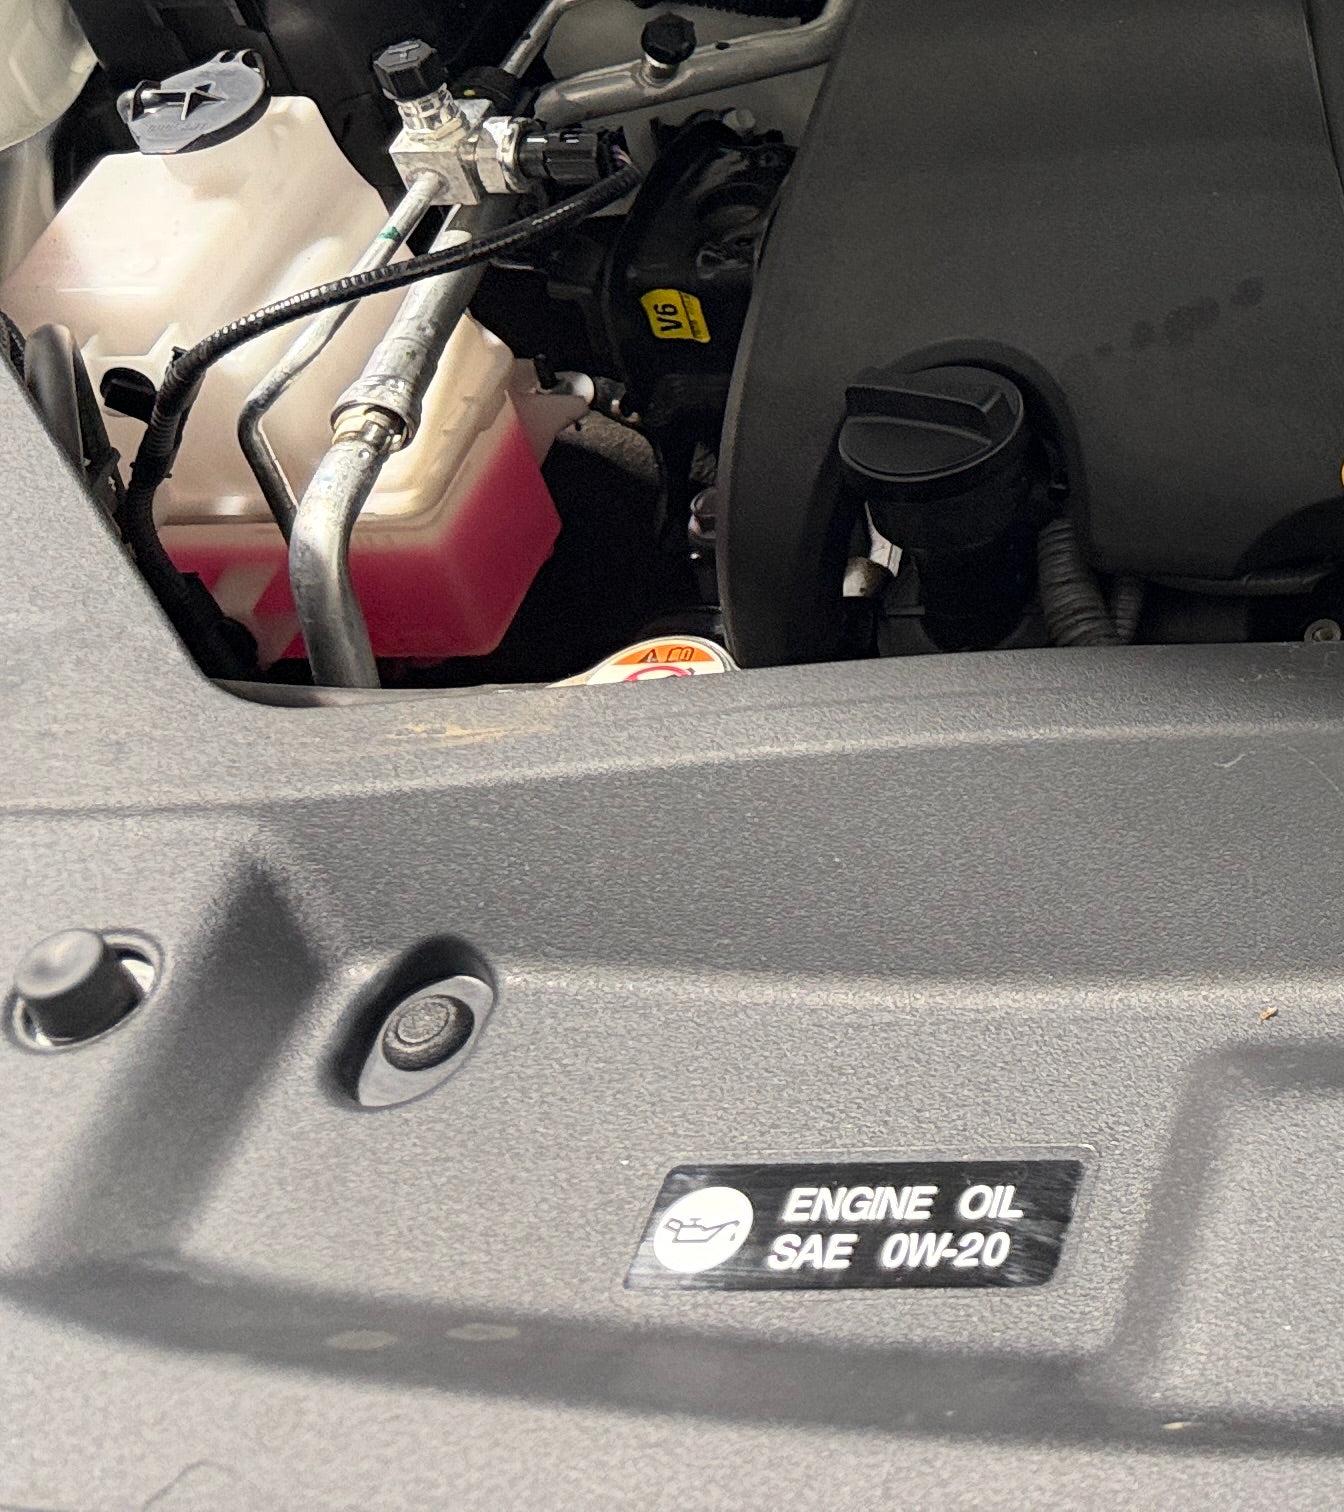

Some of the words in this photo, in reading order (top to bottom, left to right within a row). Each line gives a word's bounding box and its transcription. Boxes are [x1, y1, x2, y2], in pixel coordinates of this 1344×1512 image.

[653, 303, 684, 332] V6
[781, 1185, 939, 1223] ENGINE
[957, 1183, 1024, 1220] OIL
[767, 1232, 860, 1271] SAE
[880, 1230, 1011, 1270] 0W-20
